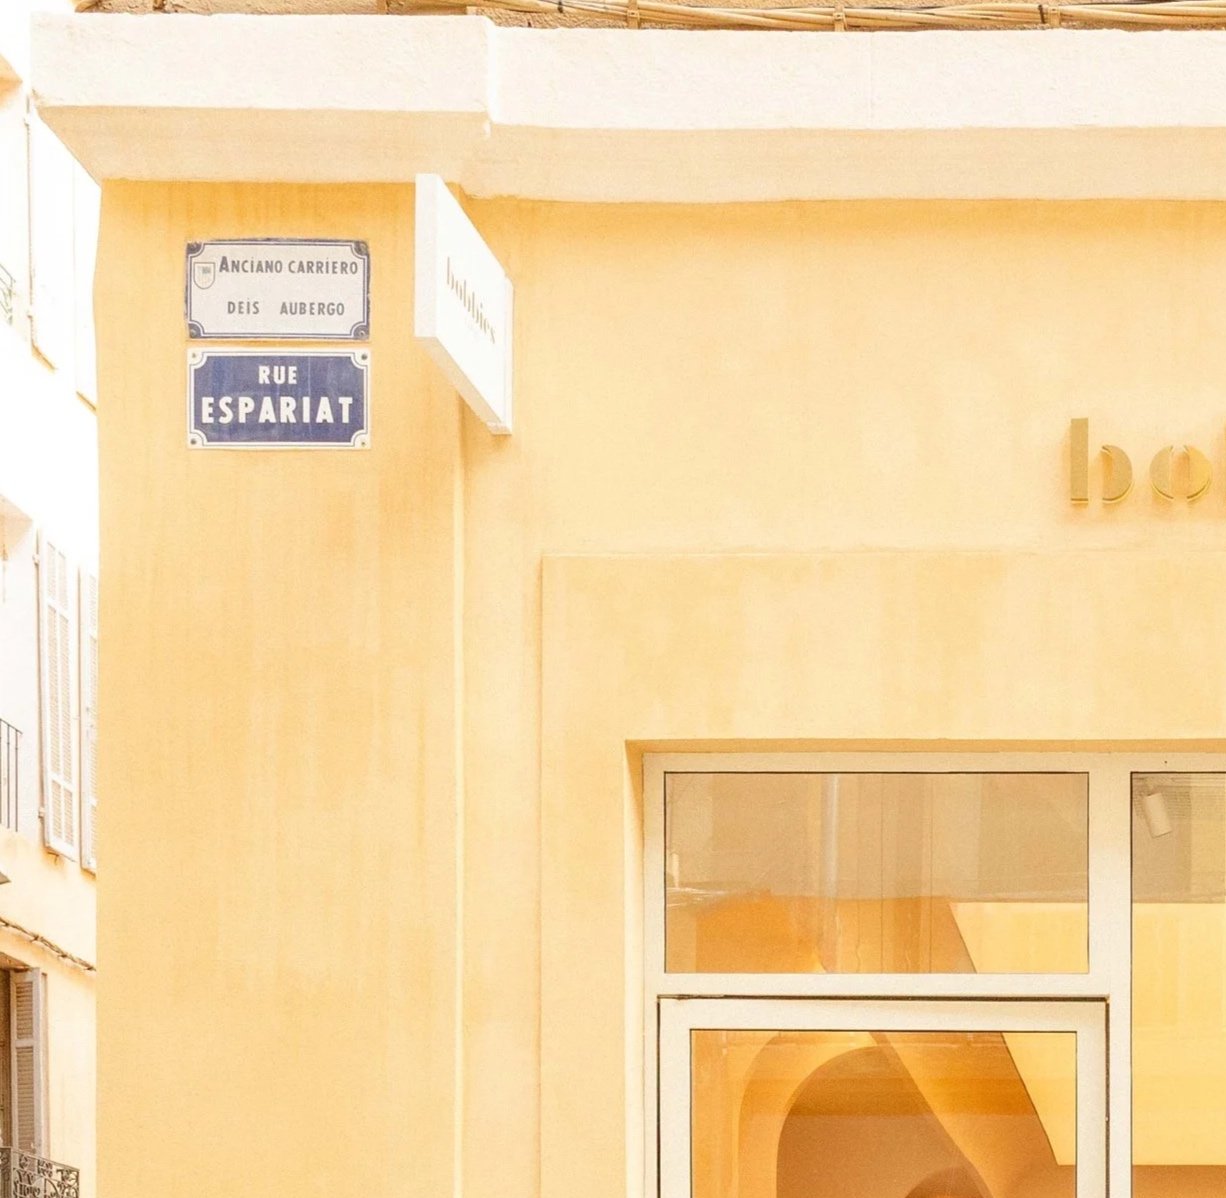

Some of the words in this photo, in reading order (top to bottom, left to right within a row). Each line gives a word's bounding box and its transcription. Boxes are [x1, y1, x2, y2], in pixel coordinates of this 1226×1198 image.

[280, 302, 345, 316] AUBERGO
[258, 365, 298, 384] RUE
[201, 396, 353, 424] ESPARIAT
